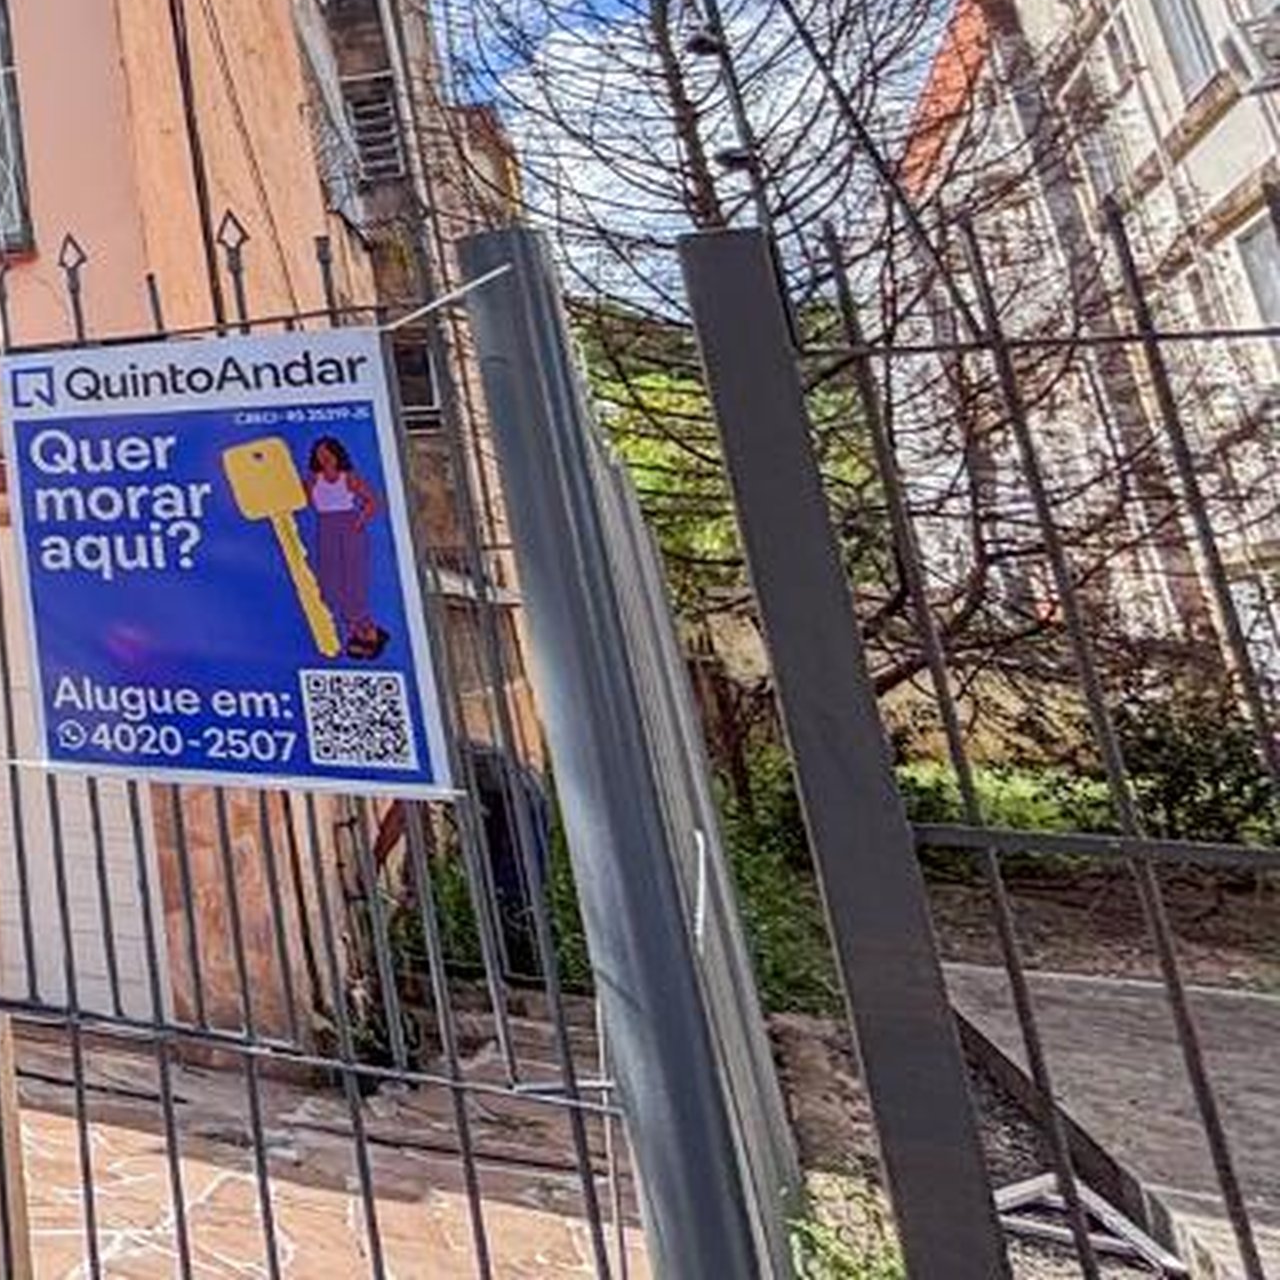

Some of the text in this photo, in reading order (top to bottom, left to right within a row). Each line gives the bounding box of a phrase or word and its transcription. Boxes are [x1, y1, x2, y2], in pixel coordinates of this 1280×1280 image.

[65, 350, 367, 401] QuintoAndar
[29, 428, 177, 475] Quer
[35, 482, 212, 522] morar
[40, 520, 201, 581] aqui?
[53, 675, 294, 721] Alugue em:
[90, 723, 297, 762] 4020-2507
